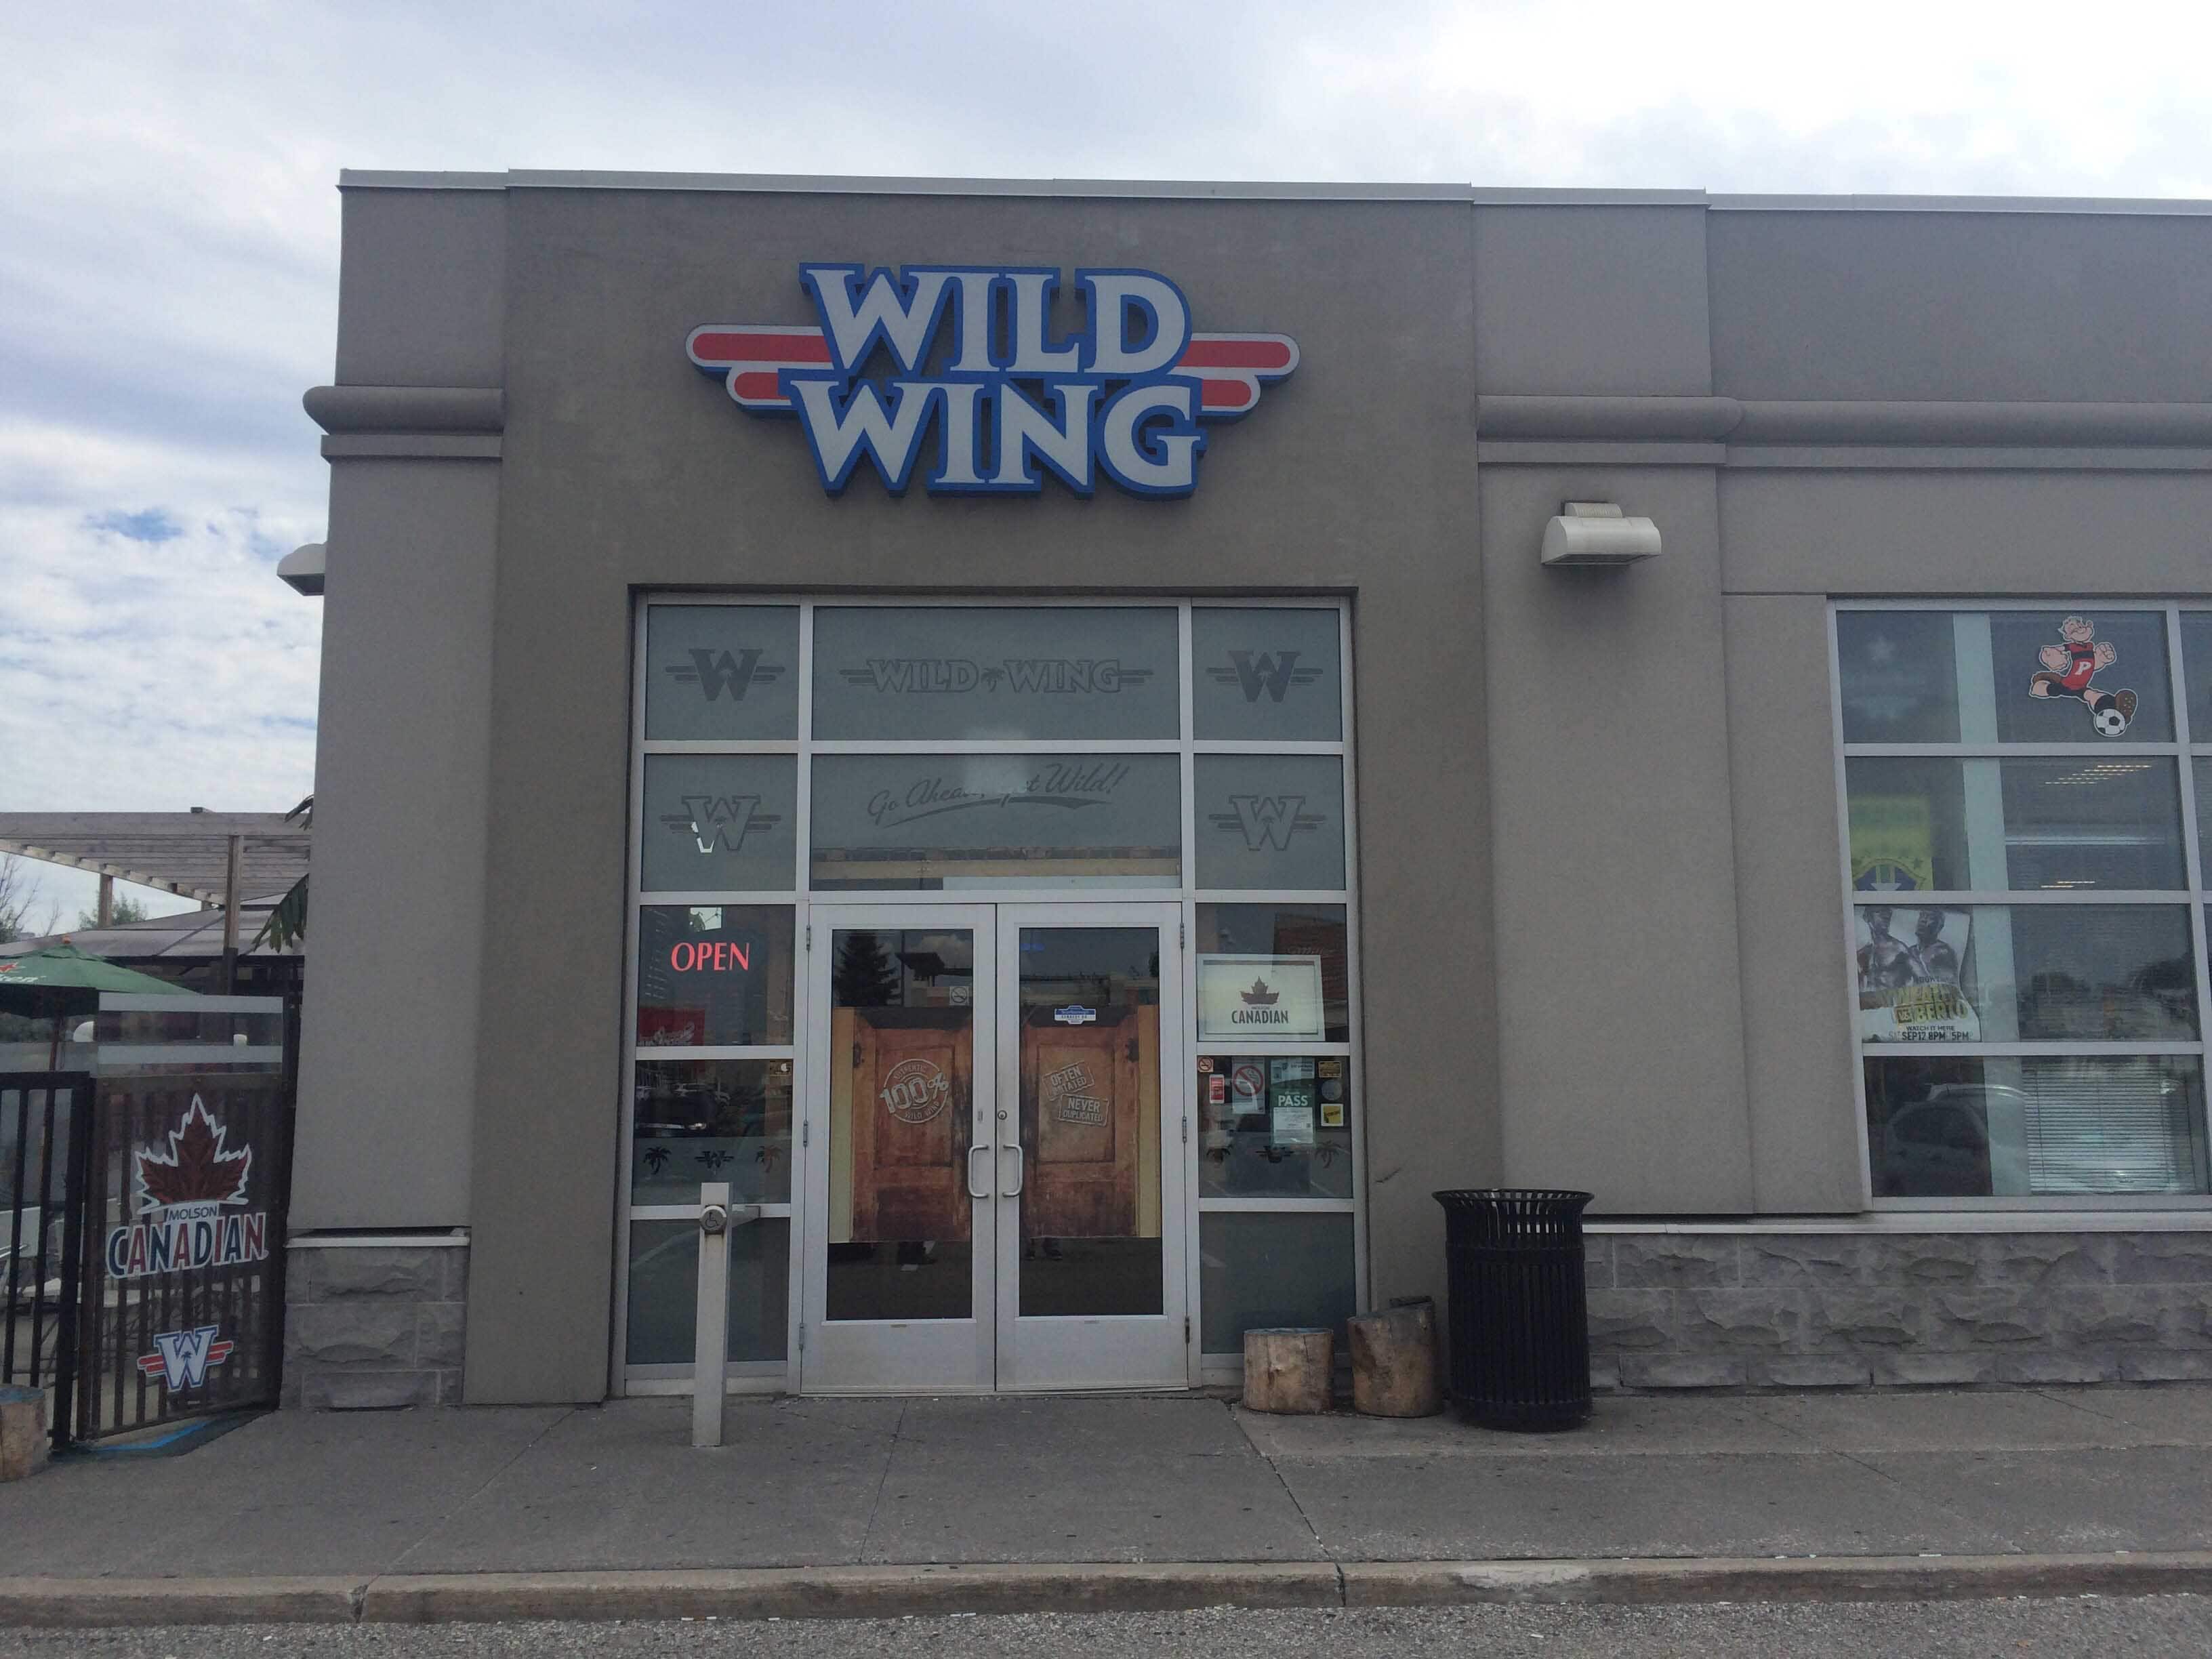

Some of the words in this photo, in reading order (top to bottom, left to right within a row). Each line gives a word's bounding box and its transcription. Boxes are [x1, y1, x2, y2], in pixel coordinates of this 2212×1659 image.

[801, 265, 1190, 377] WILD
[786, 374, 1205, 490] WING
[689, 649, 763, 701] W
[867, 659, 980, 693] WILD
[1003, 659, 1122, 693] WING
[1227, 650, 1301, 702] W
[2075, 661, 2091, 675] P
[867, 790, 898, 826] Go
[1045, 762, 1130, 794] Wild!
[681, 796, 761, 853] W
[1229, 795, 1306, 851] W
[671, 942, 750, 971] OPEN
[1231, 1010, 1290, 1024] CANADIAN
[1914, 1000, 1969, 1020] BERTO
[879, 1073, 949, 1113] 100%
[1051, 1065, 1083, 1086] OFTEN
[1063, 1109, 1103, 1122] DUPLICATED
[1067, 1098, 1101, 1113] NEVER
[1278, 1095, 1309, 1107] PASS
[169, 1207, 218, 1221] MOLSON
[106, 1213, 267, 1278] CANADIAN
[154, 1325, 220, 1393] W
